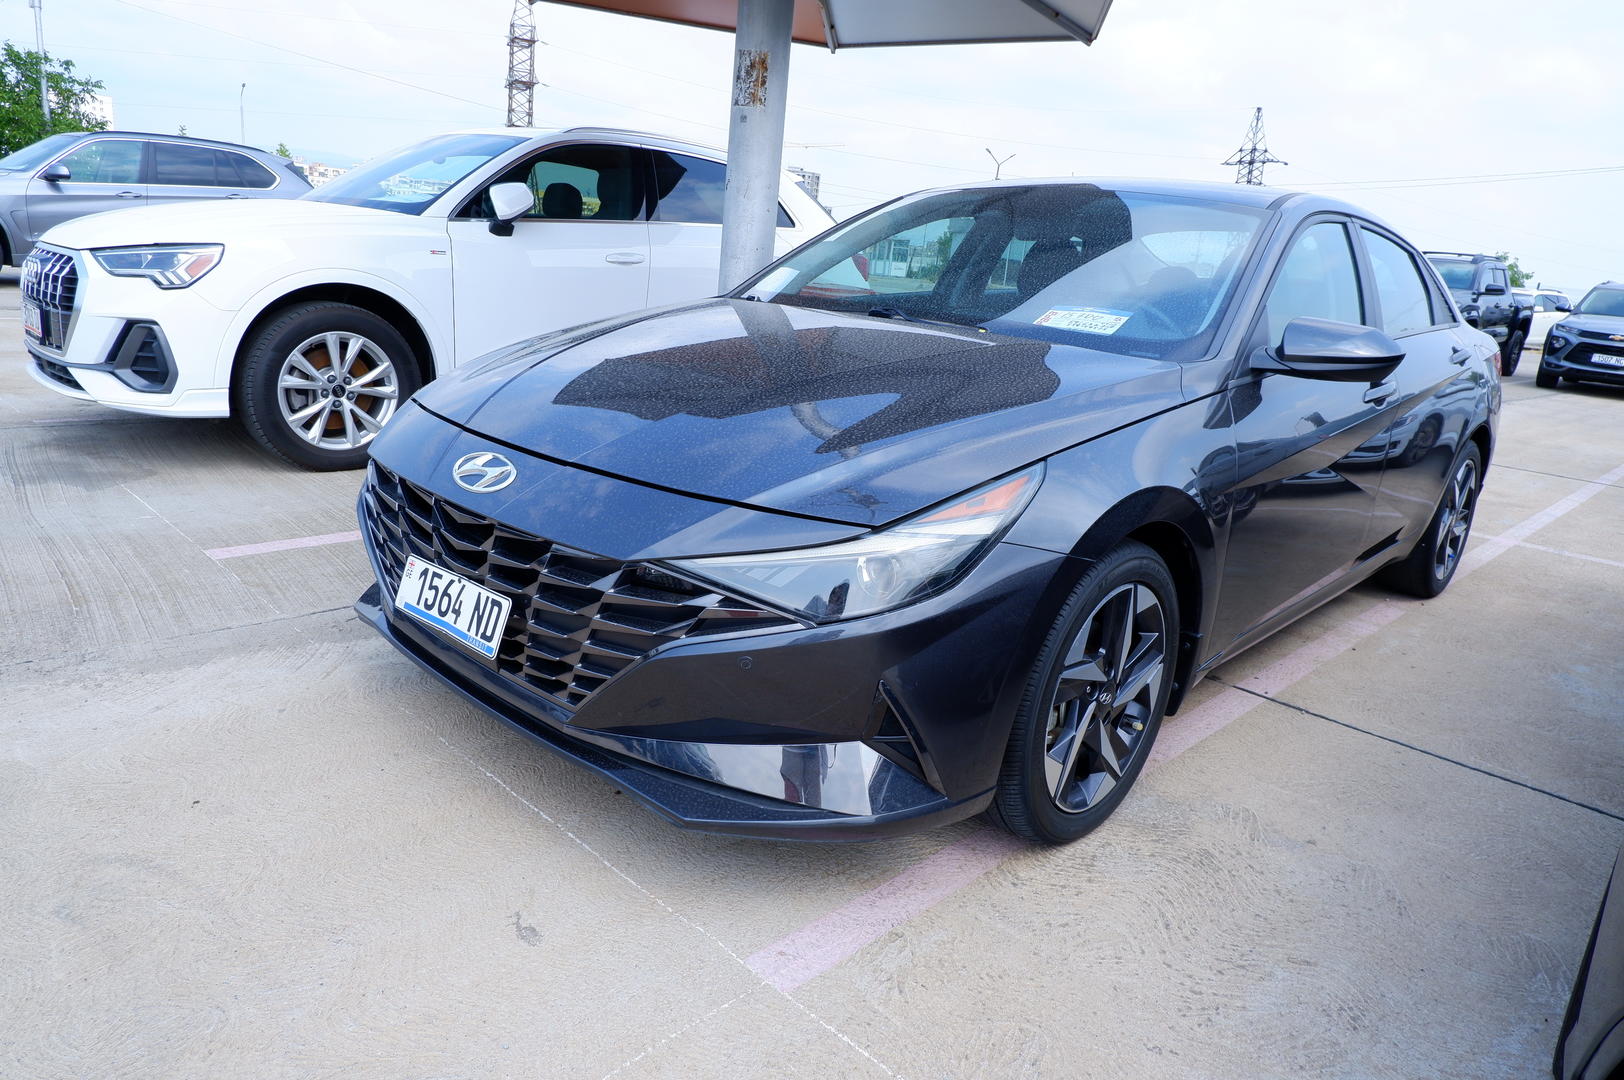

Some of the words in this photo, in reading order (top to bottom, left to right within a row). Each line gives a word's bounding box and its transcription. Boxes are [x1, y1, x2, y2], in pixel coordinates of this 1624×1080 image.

[405, 568, 414, 579] GE
[416, 567, 466, 625] 1564
[466, 591, 503, 643] ND
